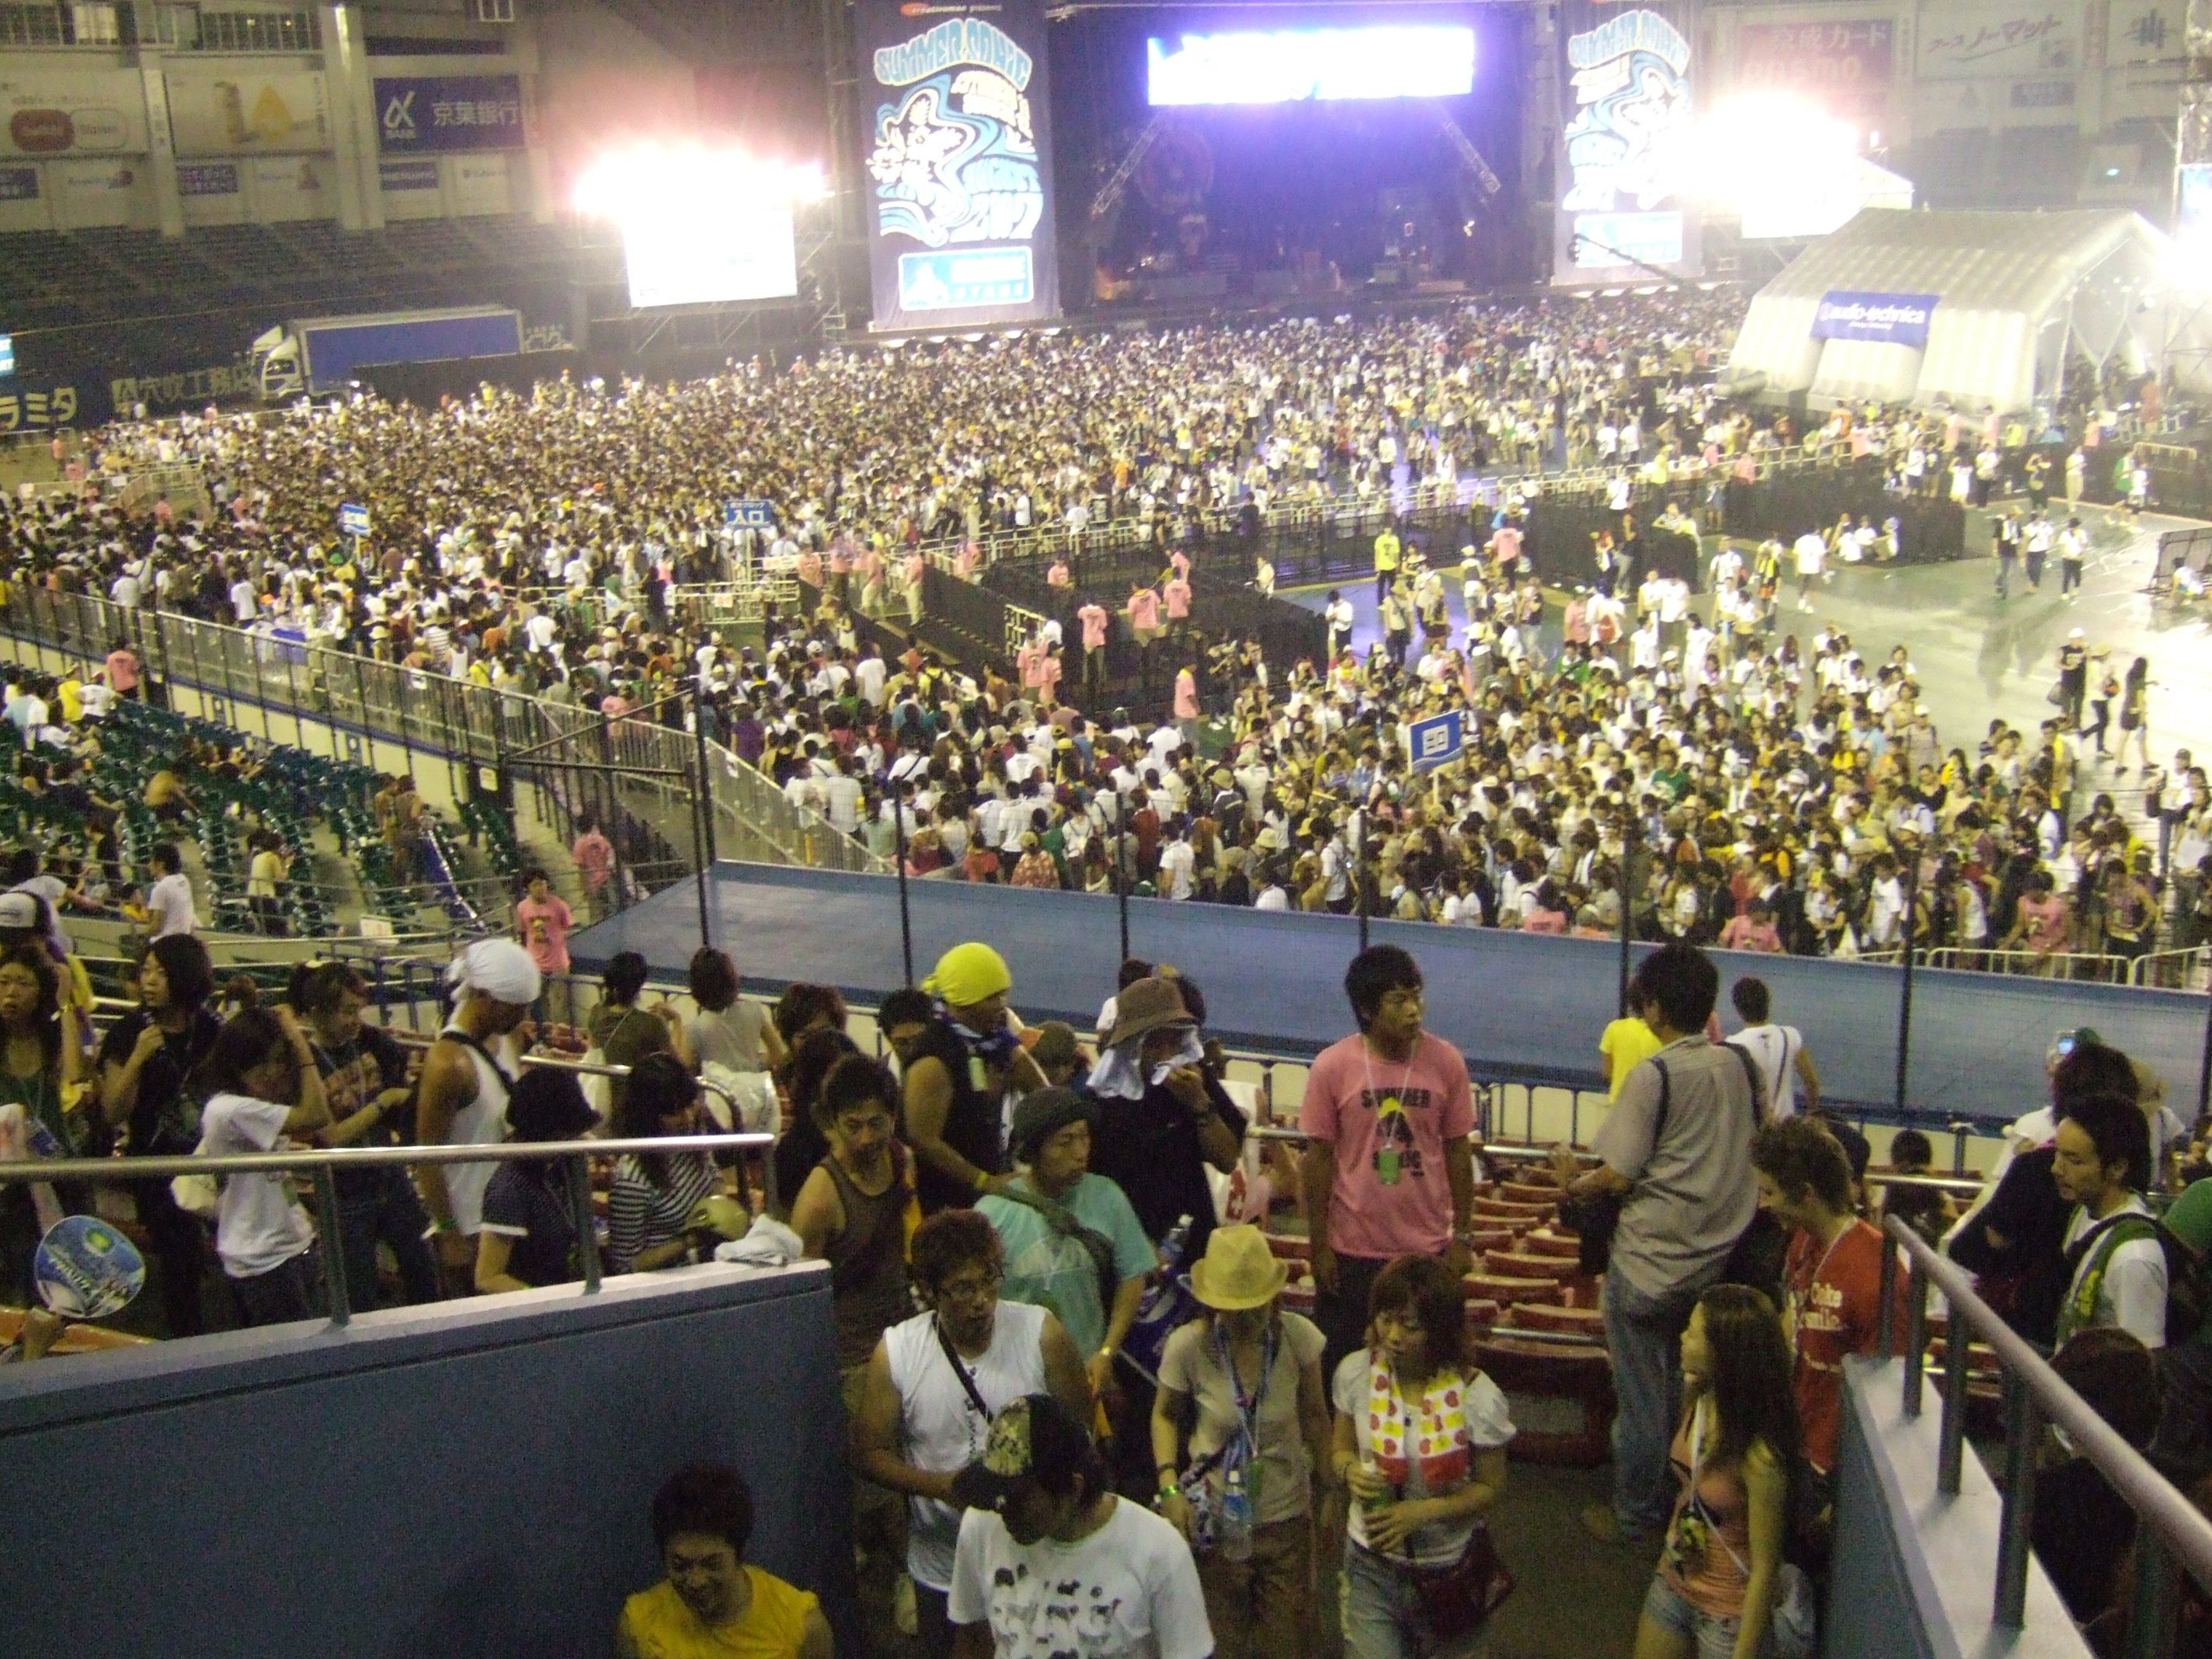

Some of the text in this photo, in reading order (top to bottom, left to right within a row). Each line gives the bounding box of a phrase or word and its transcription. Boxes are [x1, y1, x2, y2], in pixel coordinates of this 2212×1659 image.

[874, 18, 965, 85] SUMMER
[432, 100, 518, 127] 京葉銀行
[732, 510, 765, 526] 入口
[1810, 1282, 1842, 1309] Coke
